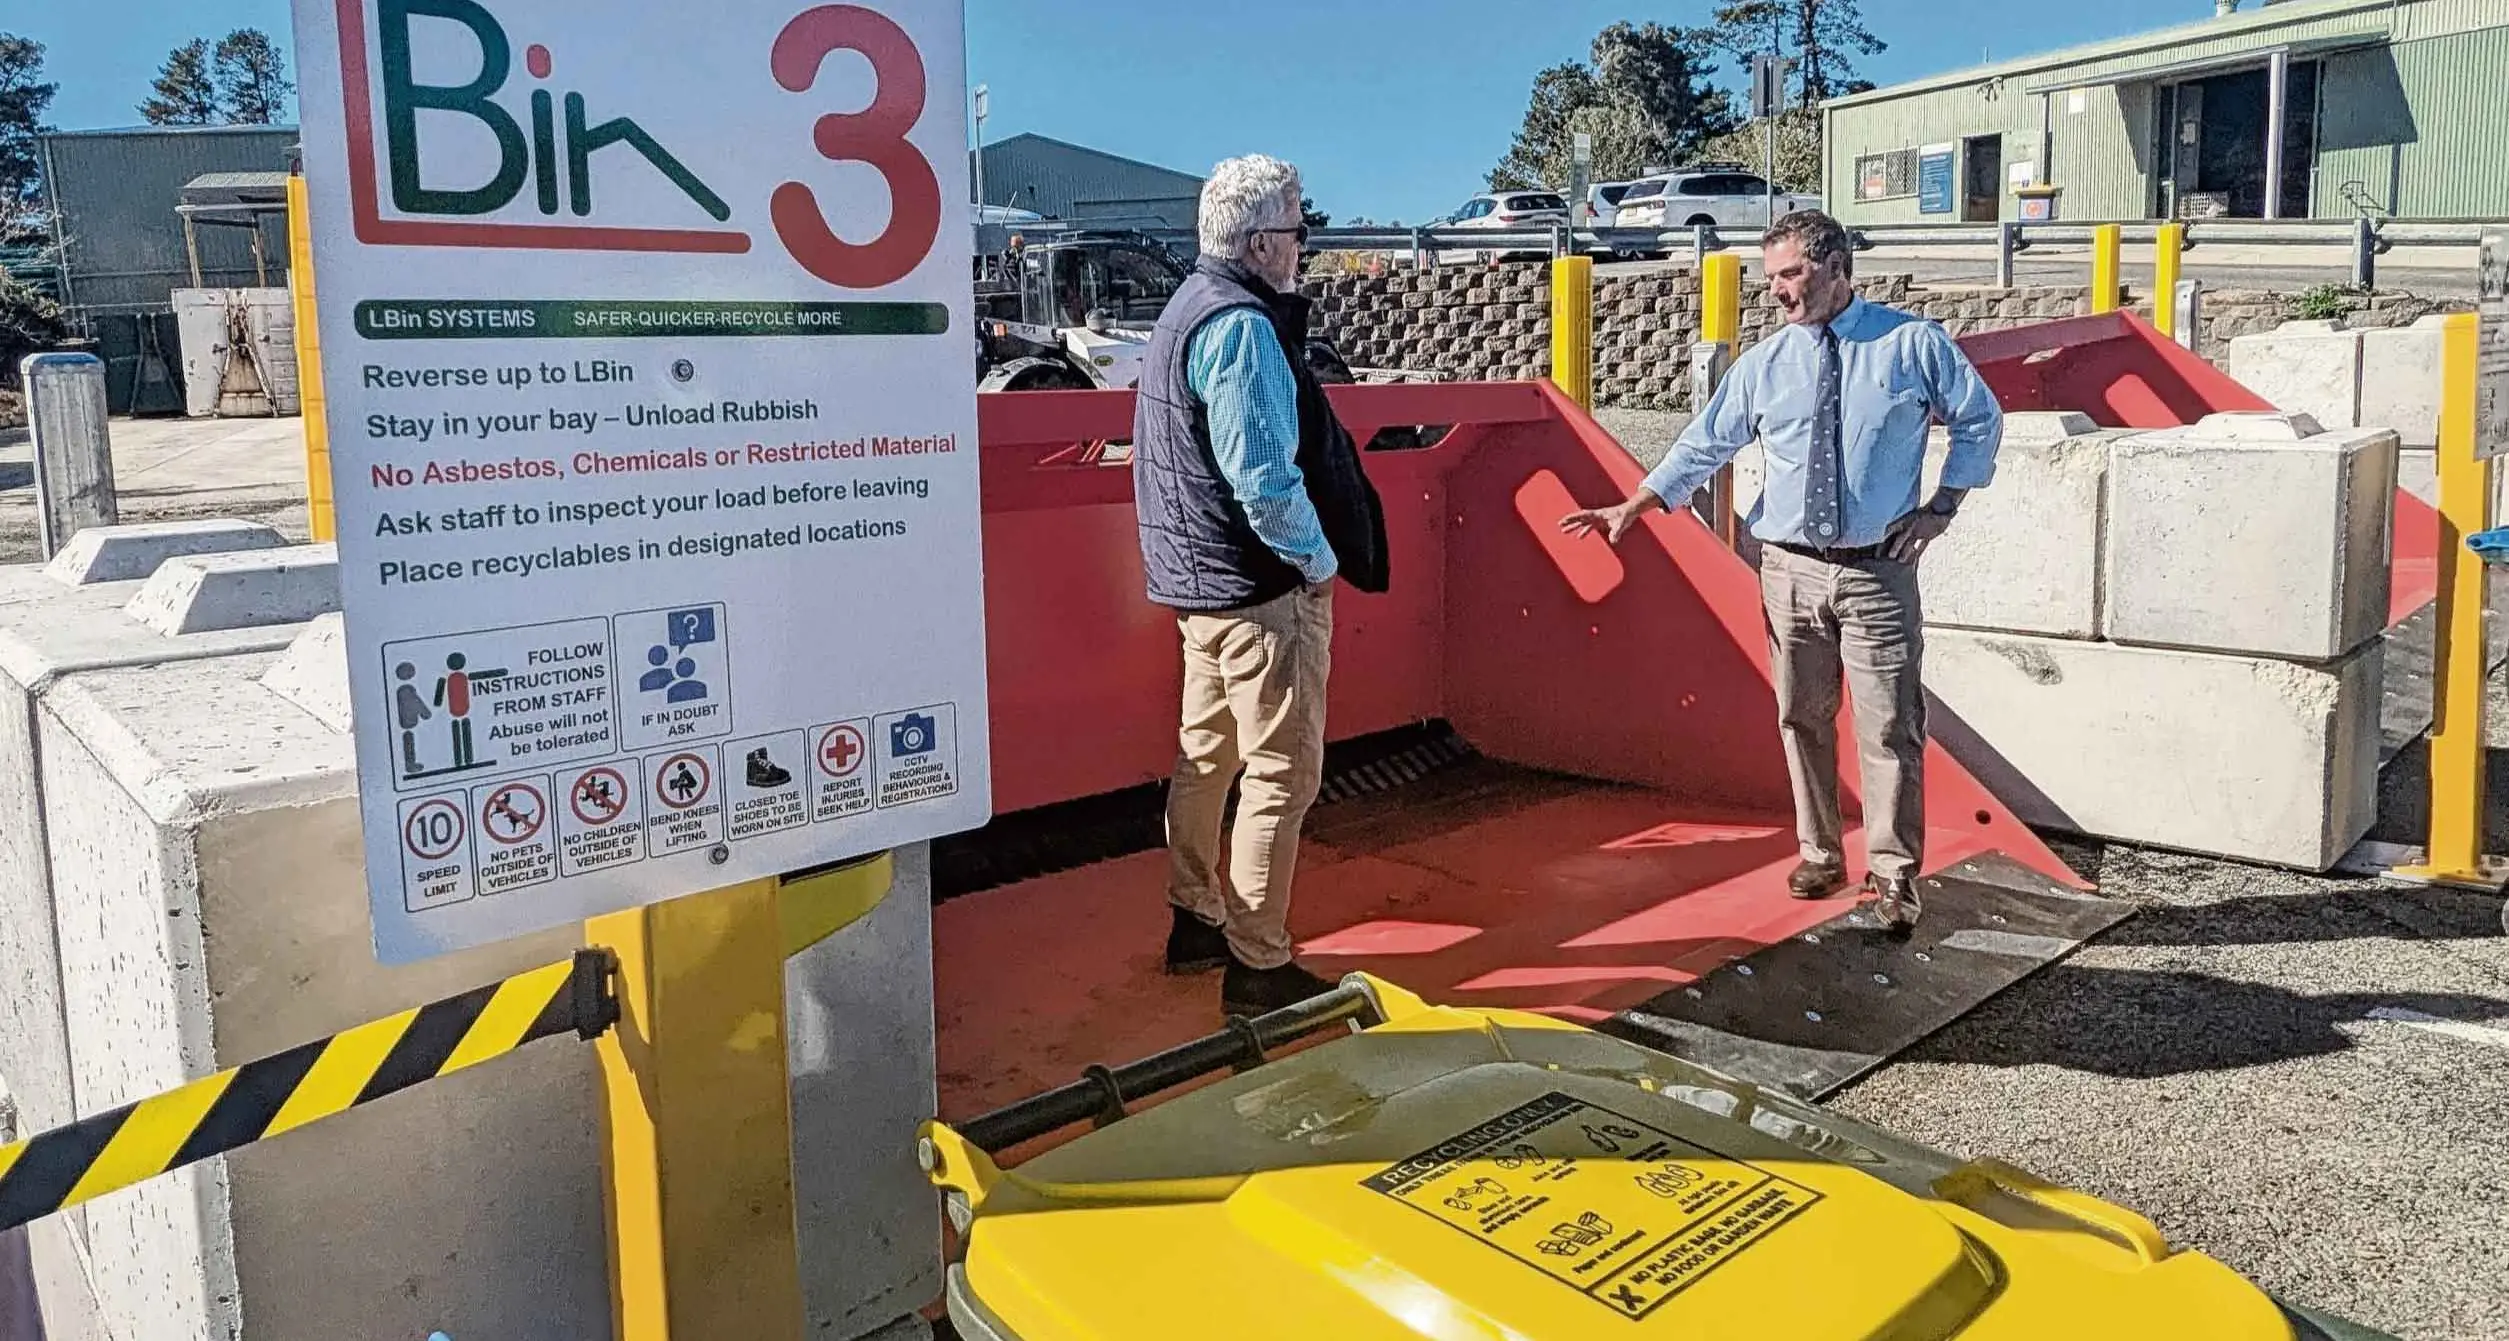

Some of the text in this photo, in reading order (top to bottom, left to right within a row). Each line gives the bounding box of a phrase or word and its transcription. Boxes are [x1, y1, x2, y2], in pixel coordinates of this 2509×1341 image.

[770, 4, 942, 289] 3
[369, 308, 536, 328] LBin SYSTEMS
[574, 310, 842, 327] SAFER-QUICKER-RECYCLE MORE
[362, 360, 634, 390] Reverse up to LBin
[367, 413, 434, 442] Stay
[443, 411, 469, 436] in
[477, 414, 542, 439] your
[550, 408, 598, 434] bay
[626, 402, 715, 427] Unload
[722, 399, 818, 423] Rubbish
[371, 433, 956, 488] No Asbestos, Chemicals or Restricted Material
[375, 476, 929, 537] Ask staff to inspect your load before leaving
[379, 518, 907, 586] Place recyclables in designated locations
[527, 641, 604, 666] FOLLOW
[471, 664, 606, 697] INSTRUCTIONS
[493, 686, 607, 717] FROM STAFF
[489, 709, 609, 740] Abuse will not
[642, 703, 719, 727] IF IN DOUBT
[510, 727, 610, 756] be tolerated
[668, 722, 696, 738] ASK
[889, 762, 944, 781] RECORDING
[904, 755, 929, 768] CCTV
[823, 776, 863, 793] REPORT
[880, 781, 953, 805] REGISTRATIONS
[882, 772, 951, 793] BEHAVIOURS &
[735, 790, 800, 812] CLOSED TOE
[817, 797, 870, 817] SEEK HELP
[821, 788, 865, 805] INJURIES
[650, 804, 720, 826] BEND KNEES
[731, 812, 806, 836] WORN ON SITE
[734, 801, 802, 824] SHOES TO BE
[416, 811, 452, 848] 10
[563, 821, 642, 847] NO CHILDREN
[668, 819, 703, 834] WHEN
[569, 833, 638, 857] OUTSIDE OF
[666, 830, 708, 848] LIFTING
[490, 842, 544, 863] NO PETS
[576, 847, 632, 868] VEHICLES
[417, 864, 461, 882] SPEED
[480, 853, 555, 878] OUTSIDE OF
[424, 881, 458, 898] LIMIT
[488, 867, 549, 889] VEHICLES
[1381, 1119, 1503, 1185] RECYCLING
[1628, 1267, 1652, 1285] NO
[1650, 1242, 1693, 1275] PLASTIC
[1719, 1212, 1740, 1228] NO
[1655, 1270, 1678, 1288] NO
[1702, 1241, 1724, 1257] OR
